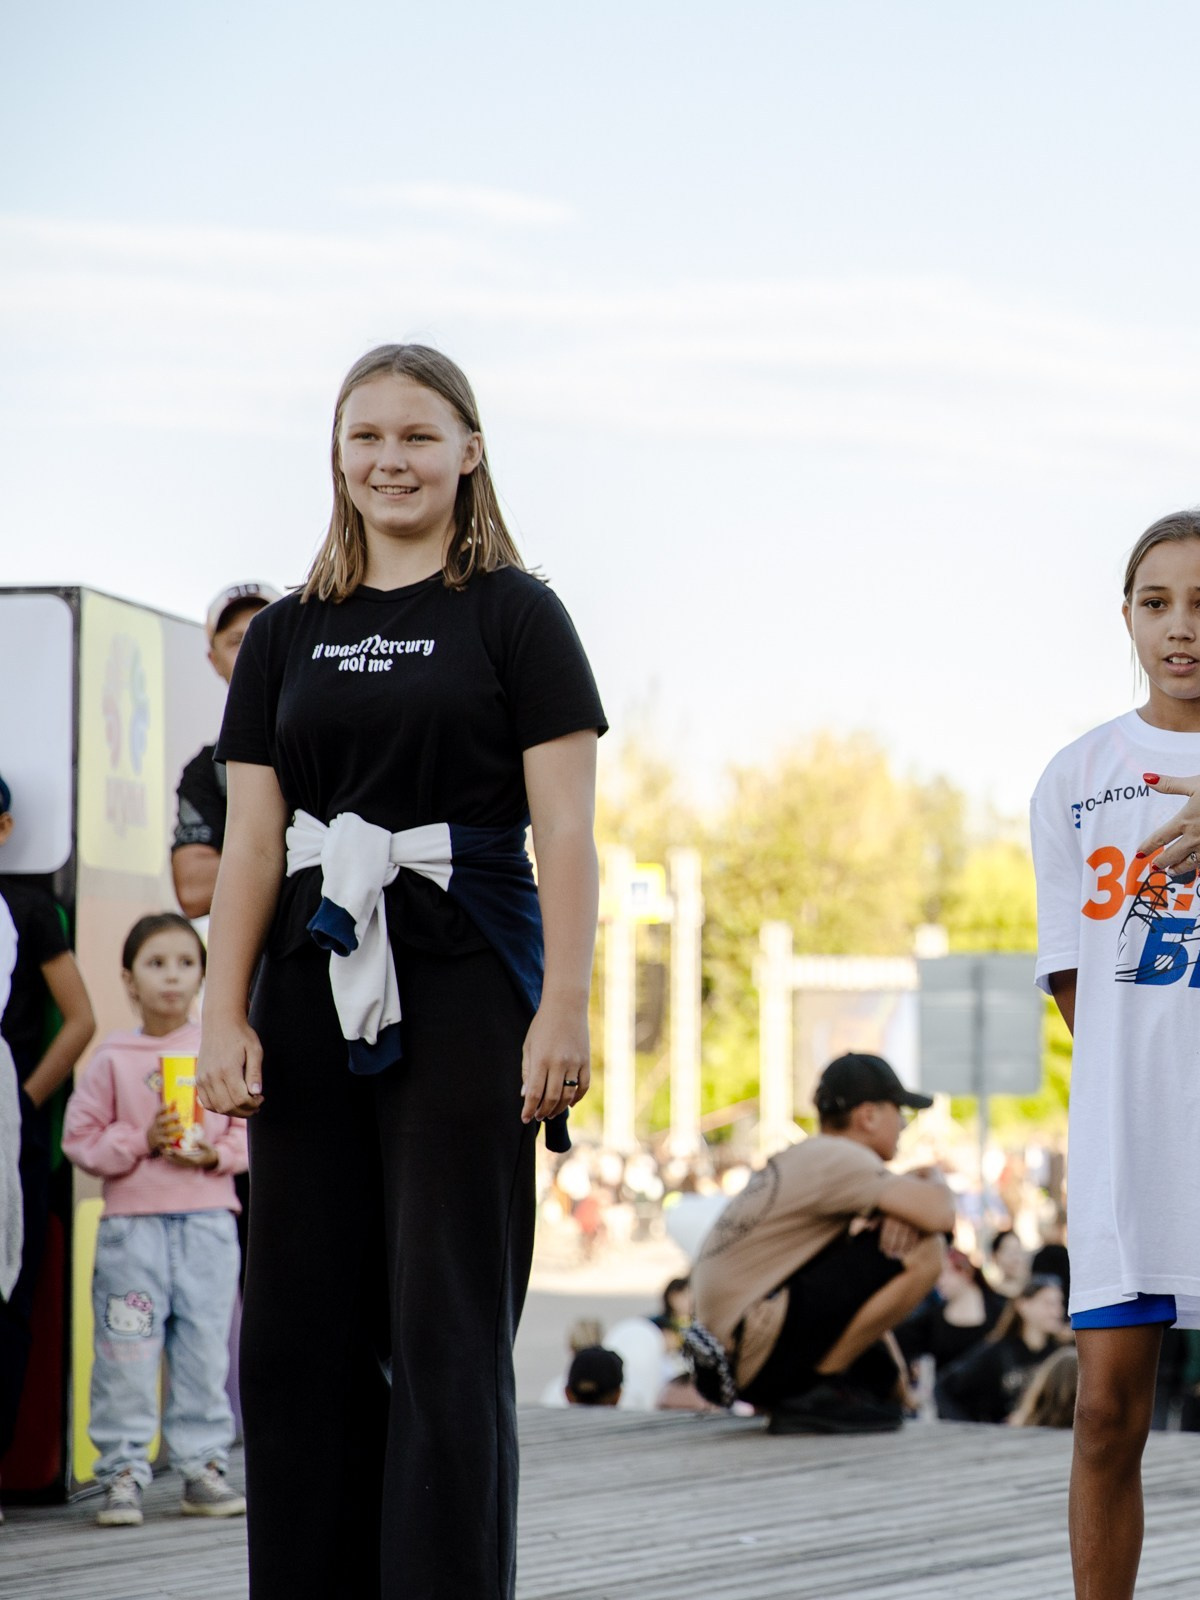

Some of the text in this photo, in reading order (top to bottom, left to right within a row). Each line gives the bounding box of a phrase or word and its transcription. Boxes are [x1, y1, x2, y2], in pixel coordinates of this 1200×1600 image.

[324, 643, 358, 658] was
[356, 634, 435, 656] Mercury
[338, 653, 394, 672] not me
